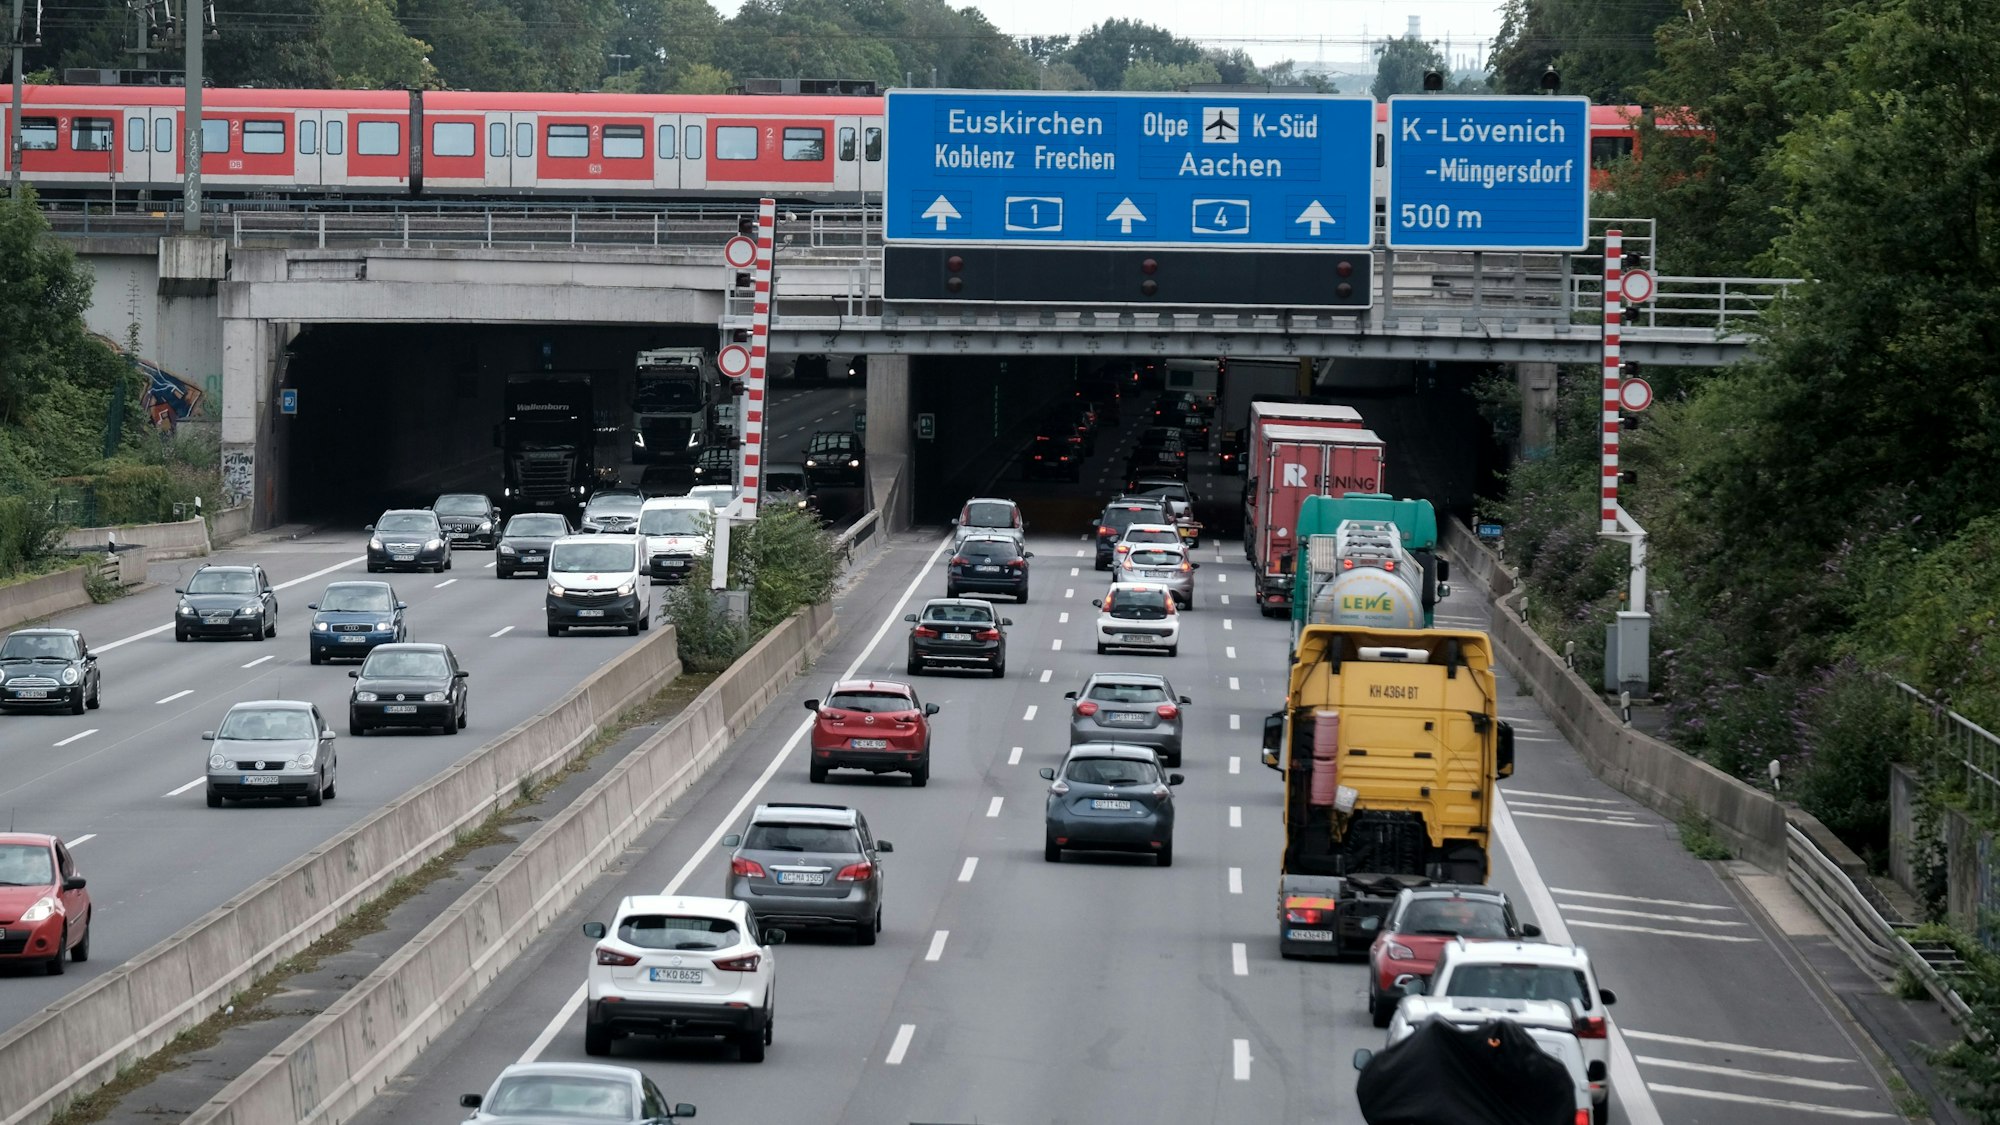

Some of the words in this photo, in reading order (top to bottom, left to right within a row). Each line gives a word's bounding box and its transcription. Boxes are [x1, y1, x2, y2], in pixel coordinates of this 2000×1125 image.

[60, 117, 68, 129] 2
[231, 120, 240, 131] 2
[592, 125, 600, 136] 2
[948, 109, 1103, 135] Euskirchen
[1143, 112, 1189, 142] Olpe
[1253, 113, 1318, 139] K-Süd
[766, 127, 774, 139] 2
[935, 143, 1015, 168] Koblenz
[1035, 145, 1115, 170] Frechen
[1178, 152, 1282, 177] Aachen
[1425, 157, 1573, 188] -Müngersdorf
[1029, 203, 1039, 225] 1
[1213, 206, 1228, 227] 4
[1401, 203, 1450, 229] 500
[1457, 210, 1482, 229] m
[516, 402, 570, 411] Wallenborn
[1343, 593, 1392, 611] LEWE
[1369, 684, 1382, 698] KH
[1383, 685, 1406, 699] 4364
[1408, 686, 1419, 700] BT
[666, 971, 678, 979] KQ
[679, 972, 701, 981] 8625
